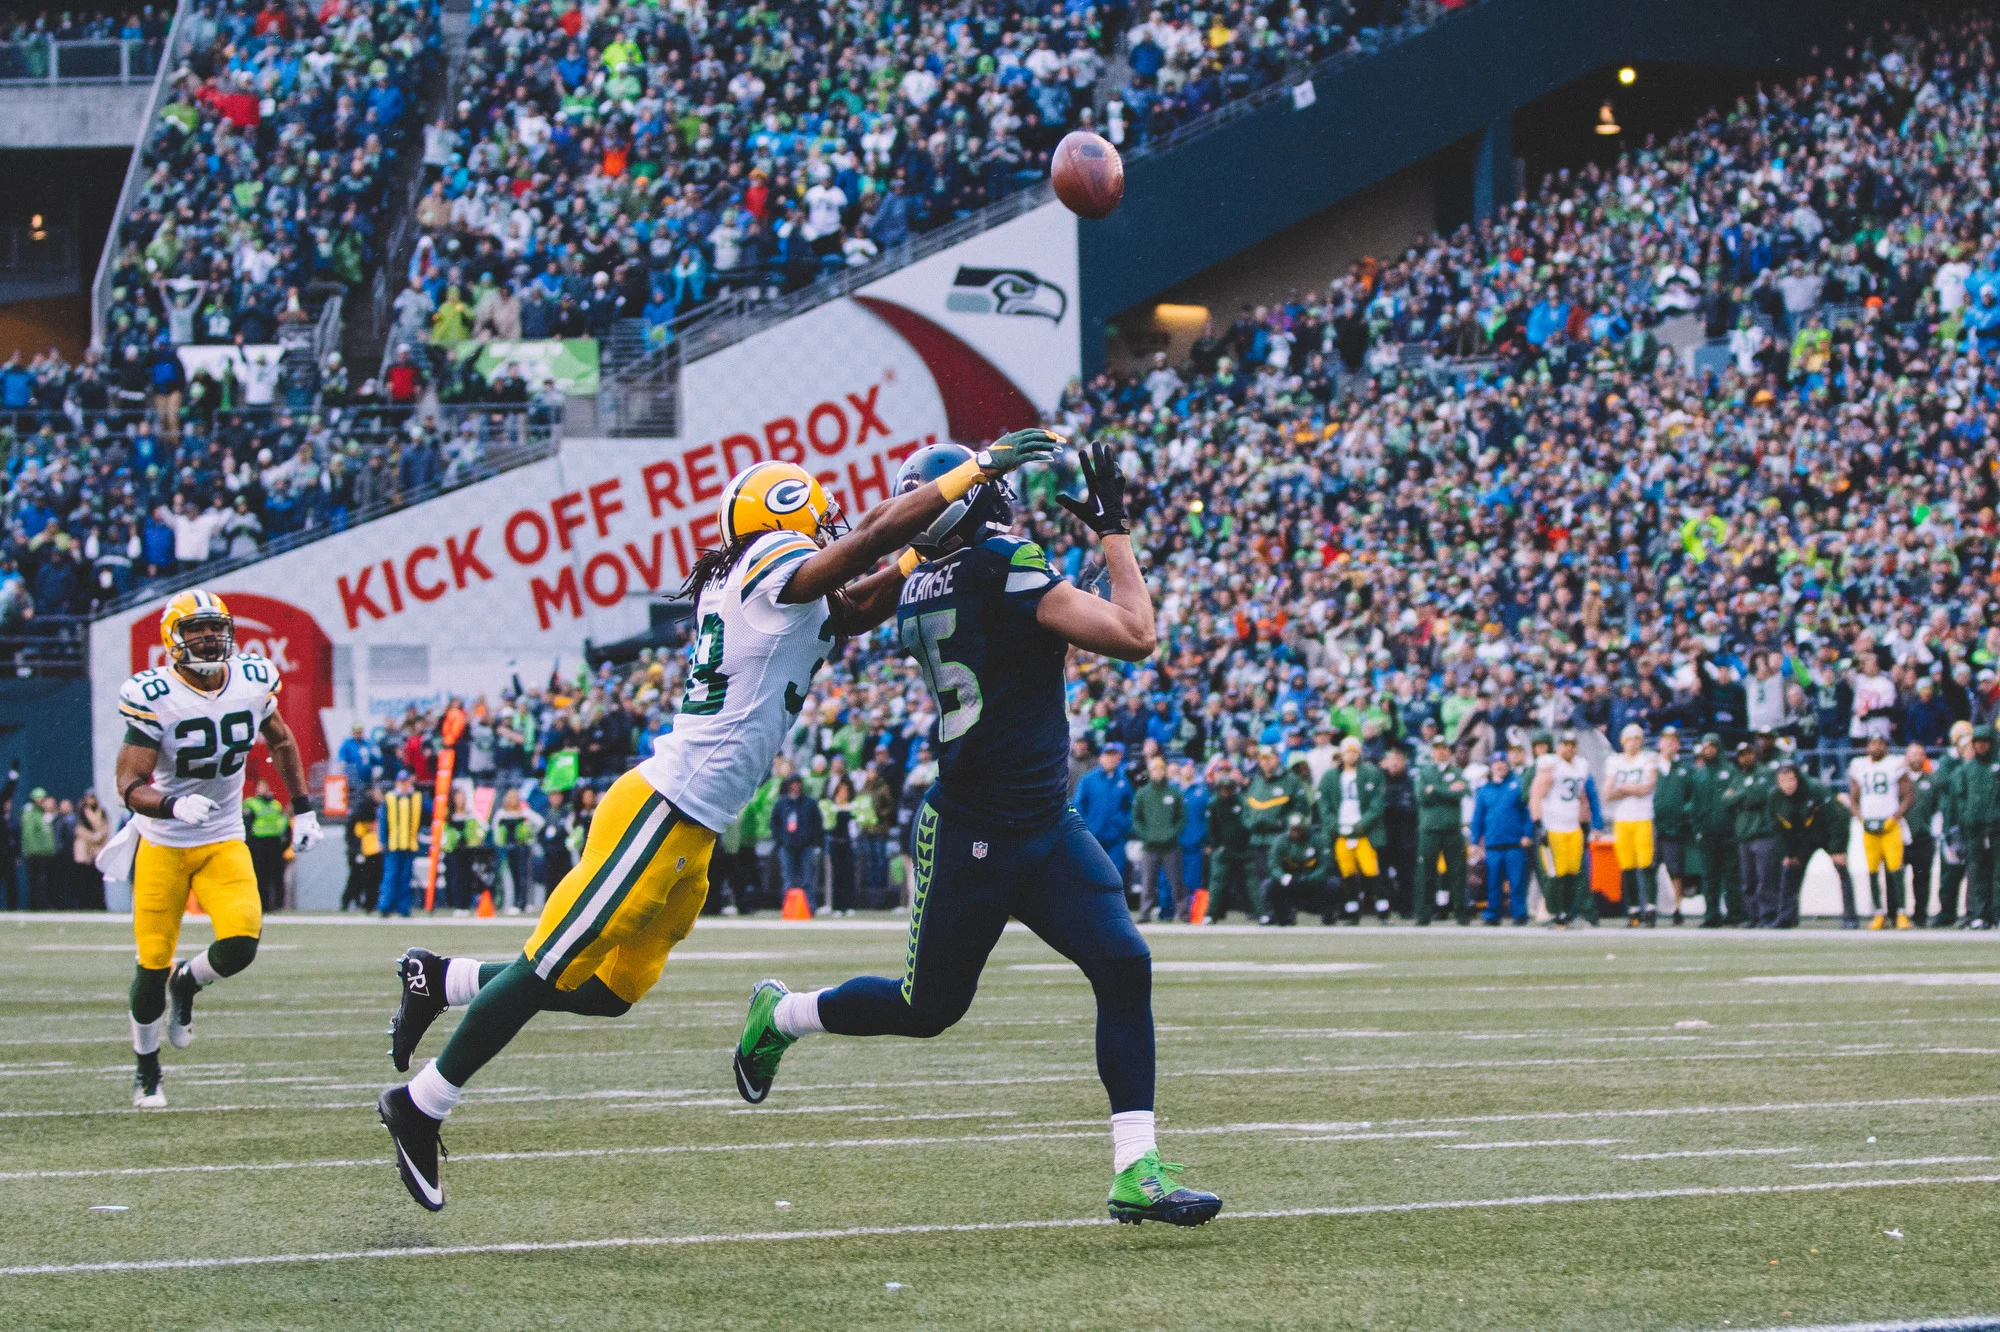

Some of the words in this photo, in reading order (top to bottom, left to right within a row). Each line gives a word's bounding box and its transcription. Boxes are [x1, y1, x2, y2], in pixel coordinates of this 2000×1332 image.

[336, 526, 494, 630] KICK
[503, 479, 623, 566] OFF
[641, 386, 890, 519] REDBOX
[529, 511, 723, 631] MOVIE
[900, 561, 962, 606] KEARSE
[174, 709, 255, 780] 28
[1863, 771, 1888, 795] 18
